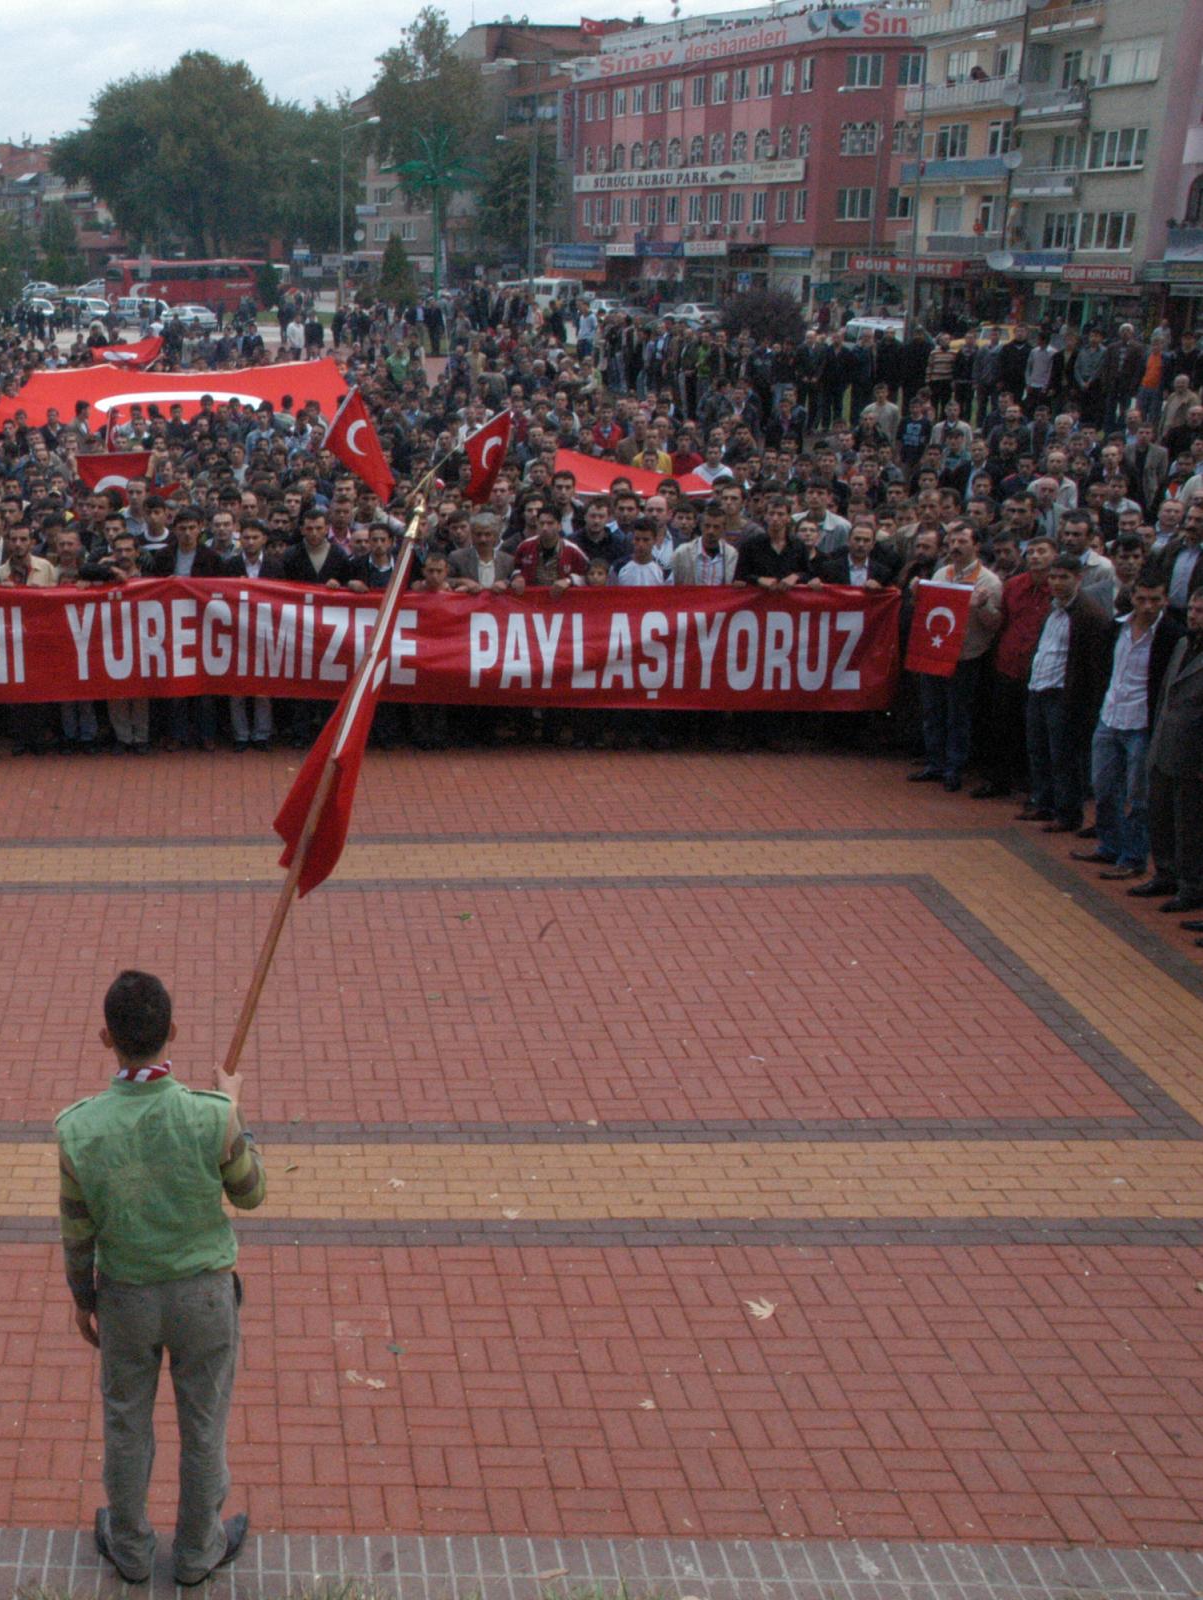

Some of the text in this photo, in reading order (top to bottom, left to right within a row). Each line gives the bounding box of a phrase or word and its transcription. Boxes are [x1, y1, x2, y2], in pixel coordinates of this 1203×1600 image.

[863, 11, 921, 35] Sın
[599, 28, 787, 76] Sınav dershaneleri
[636, 173, 673, 186] KURSU
[676, 171, 708, 184] PARK
[896, 262, 954, 274] MRKET
[469, 610, 863, 699] PAYLAŞIYORUZ
